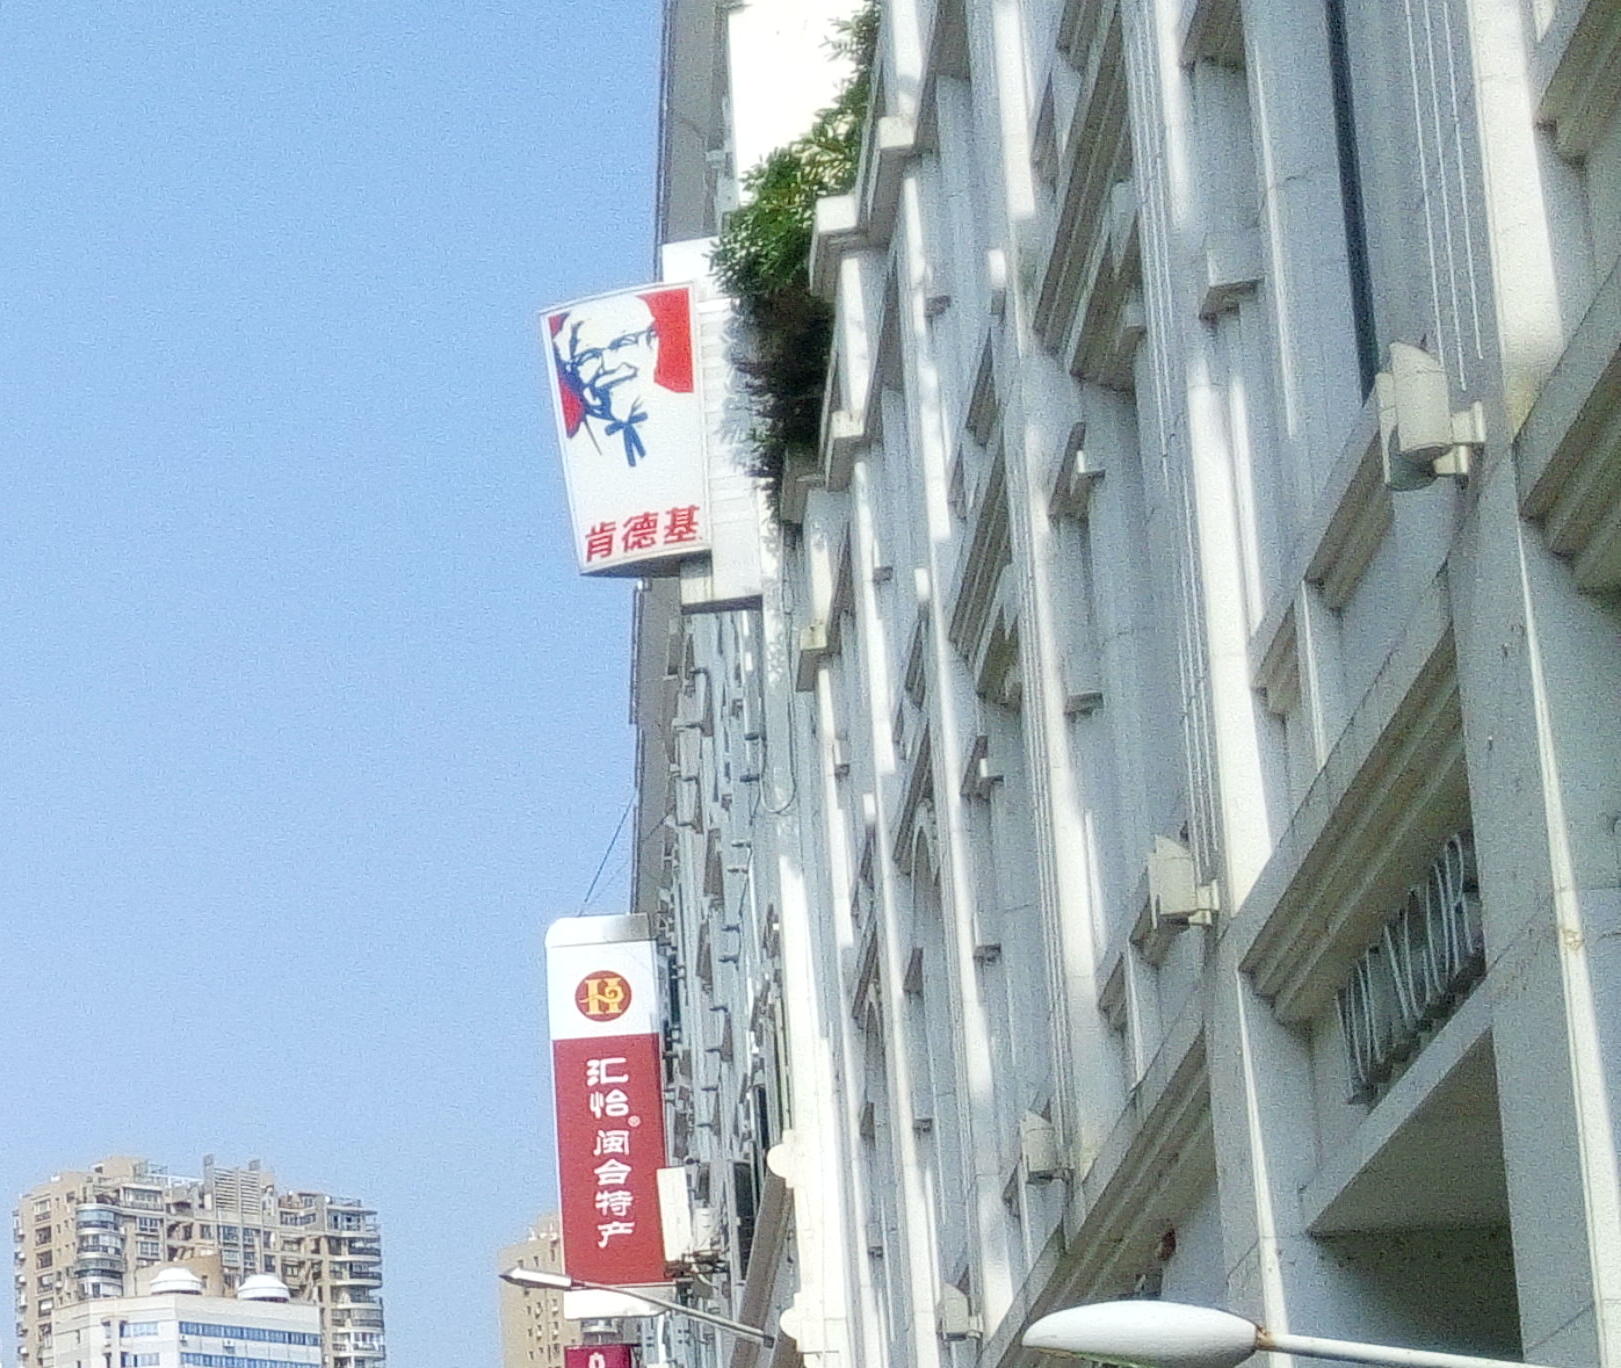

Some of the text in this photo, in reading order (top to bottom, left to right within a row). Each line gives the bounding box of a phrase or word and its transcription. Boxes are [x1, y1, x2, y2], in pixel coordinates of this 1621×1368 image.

[585, 504, 701, 563] 肯德基
[586, 1056, 629, 1119] 汇怡
